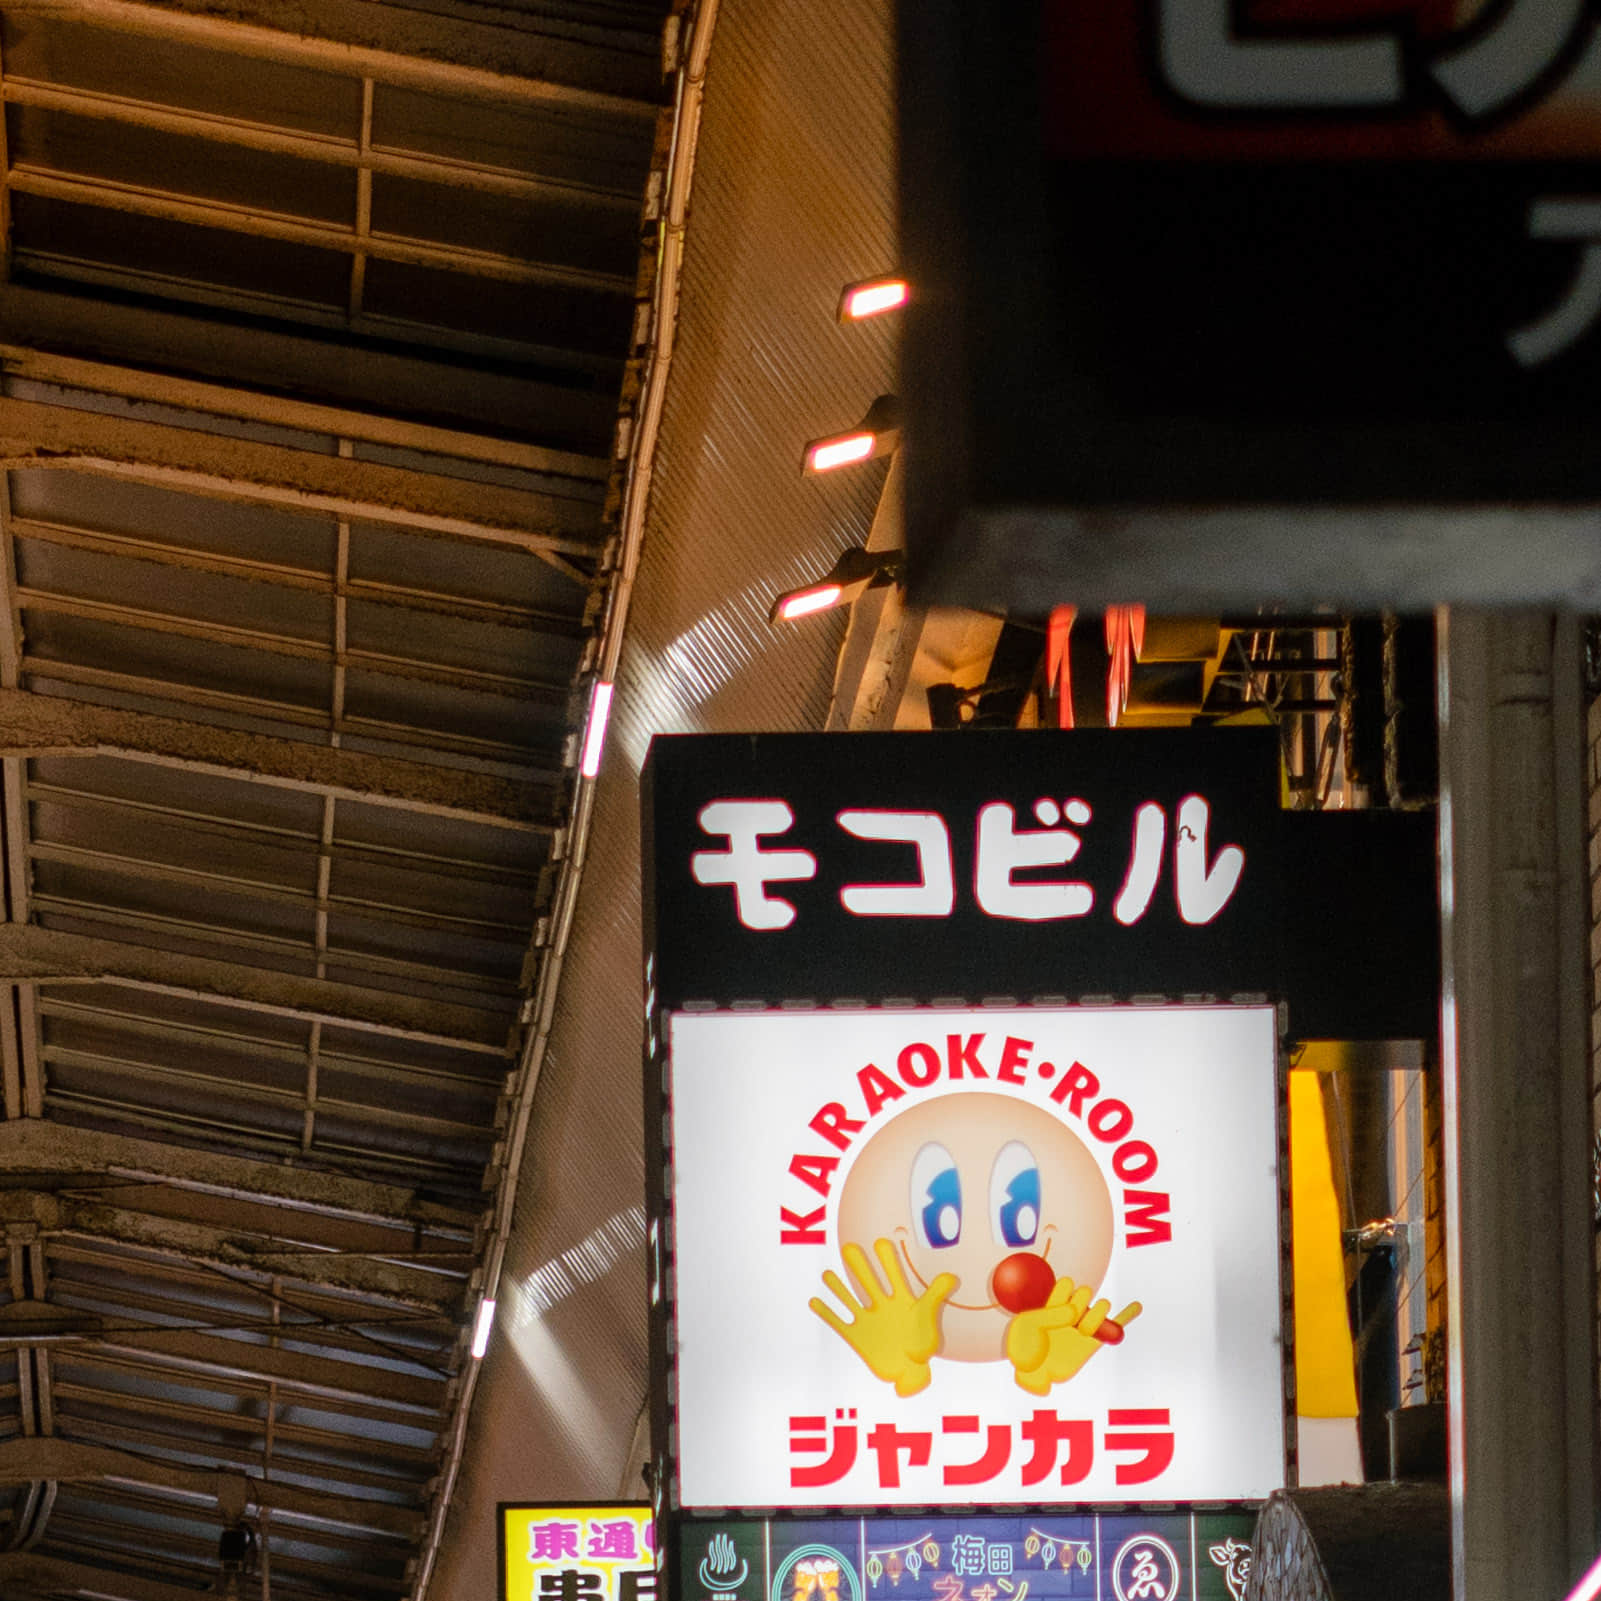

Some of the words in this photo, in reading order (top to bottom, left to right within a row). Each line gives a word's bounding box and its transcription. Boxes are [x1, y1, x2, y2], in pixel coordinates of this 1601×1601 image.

[692, 796, 1245, 930] モコビル
[789, 1407, 1176, 1489] ジャンカラ
[530, 1522, 656, 1560] 東通
[952, 1534, 1013, 1576] 梅田
